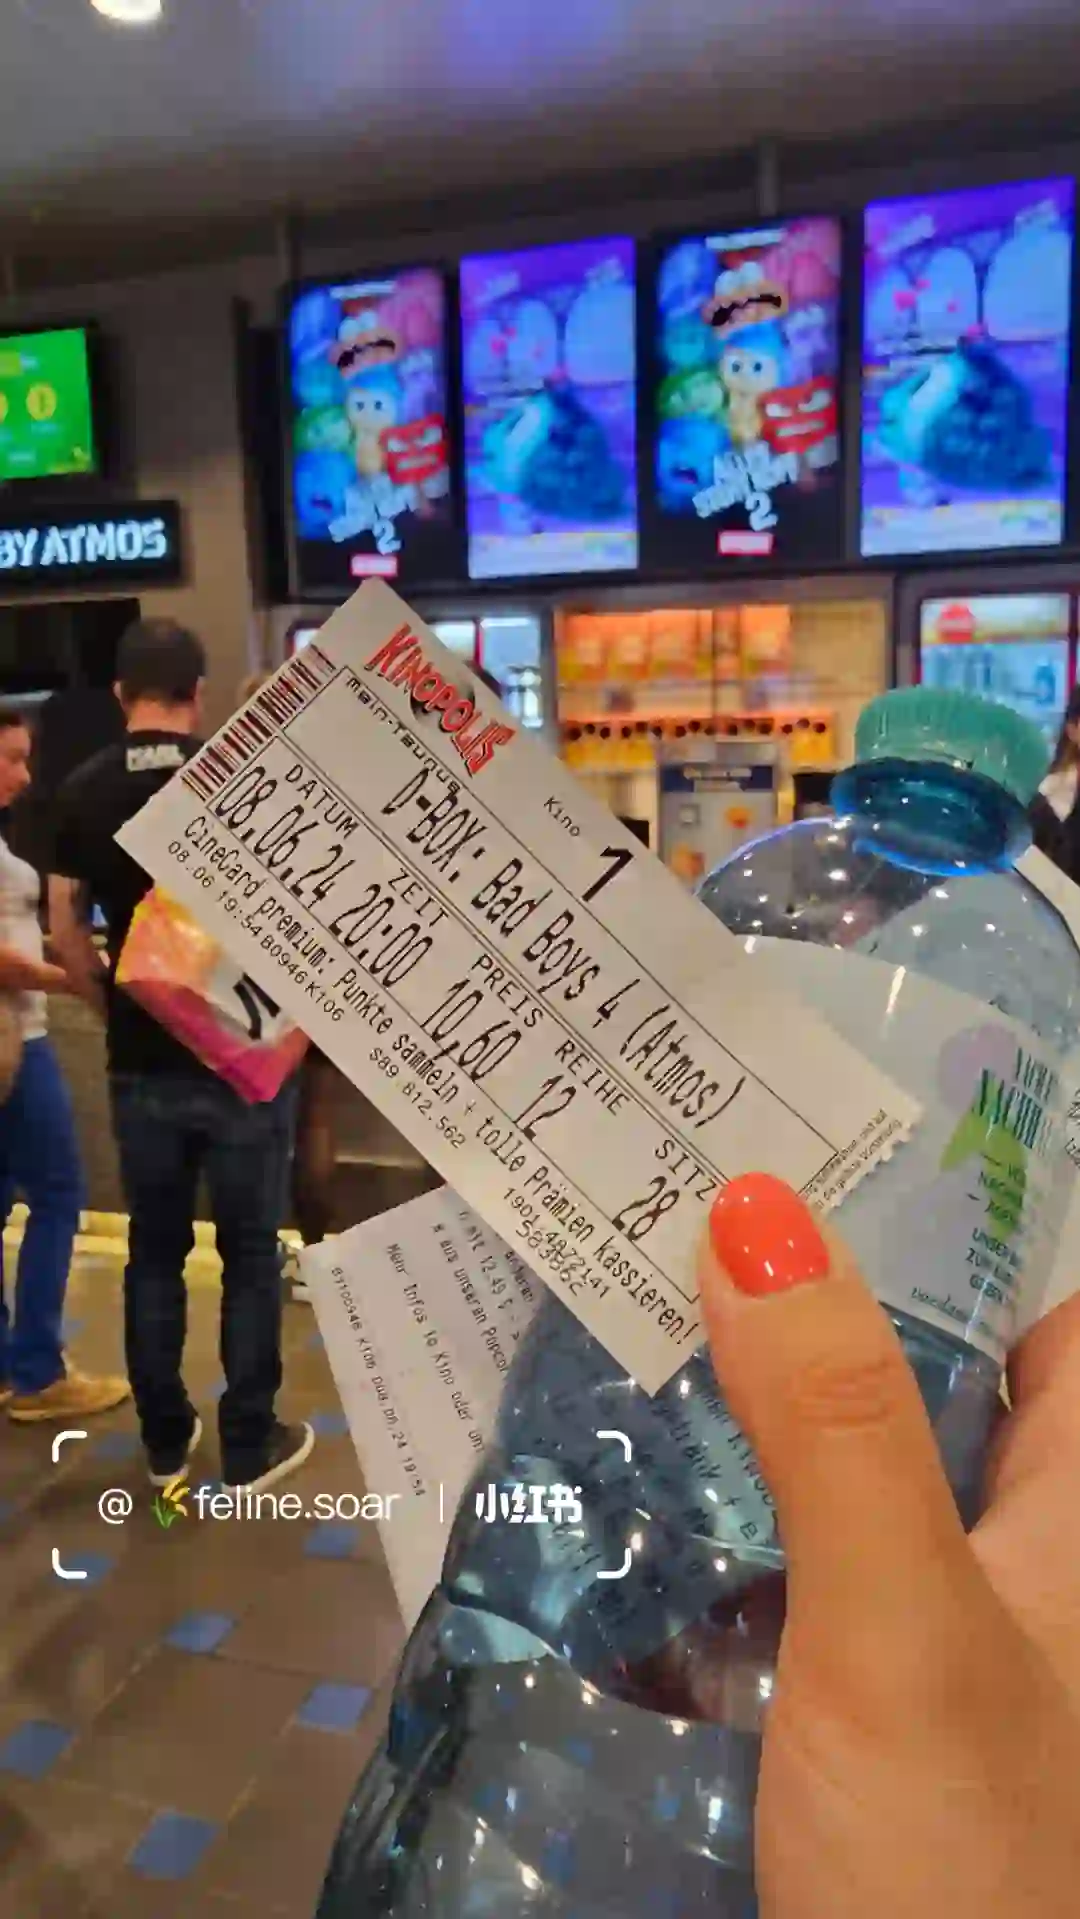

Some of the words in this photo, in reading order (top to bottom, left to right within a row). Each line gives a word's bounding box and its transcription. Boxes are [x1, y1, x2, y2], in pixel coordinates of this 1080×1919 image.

[40, 517, 168, 566] ATMOS
[365, 623, 516, 777] KINOPOLIS
[381, 767, 486, 882] D-BOX:
[542, 795, 580, 837] Kino
[581, 845, 634, 902] 1
[217, 889, 263, 937] 19:54
[470, 857, 553, 937] Bad
[215, 766, 353, 909] 08.06.24
[327, 883, 433, 988] 20:00
[415, 978, 521, 1084] 10,60
[507, 1074, 576, 1141] 12
[609, 1175, 680, 1246] 28
[284, 763, 359, 839] DATUM
[387, 867, 449, 927] ZEIT
[470, 952, 543, 1028] PREIS
[553, 1038, 630, 1115] REIHE
[654, 1138, 717, 1202] SITZ
[510, 909, 600, 1014] Boys
[591, 977, 640, 1029] 4
[183, 815, 266, 899] CineCard
[251, 895, 335, 974] premium:
[332, 967, 393, 1034] Punkte
[391, 1033, 459, 1103] sammeln
[475, 1115, 526, 1172] tolle
[523, 1165, 595, 1242] Prämien
[593, 1235, 700, 1344] kassieren!
[619, 1004, 745, 1127] (Atmos)
[402, 1282, 428, 1324] Infos
[432, 1350, 454, 1385] Kino
[450, 1390, 473, 1420] oder
